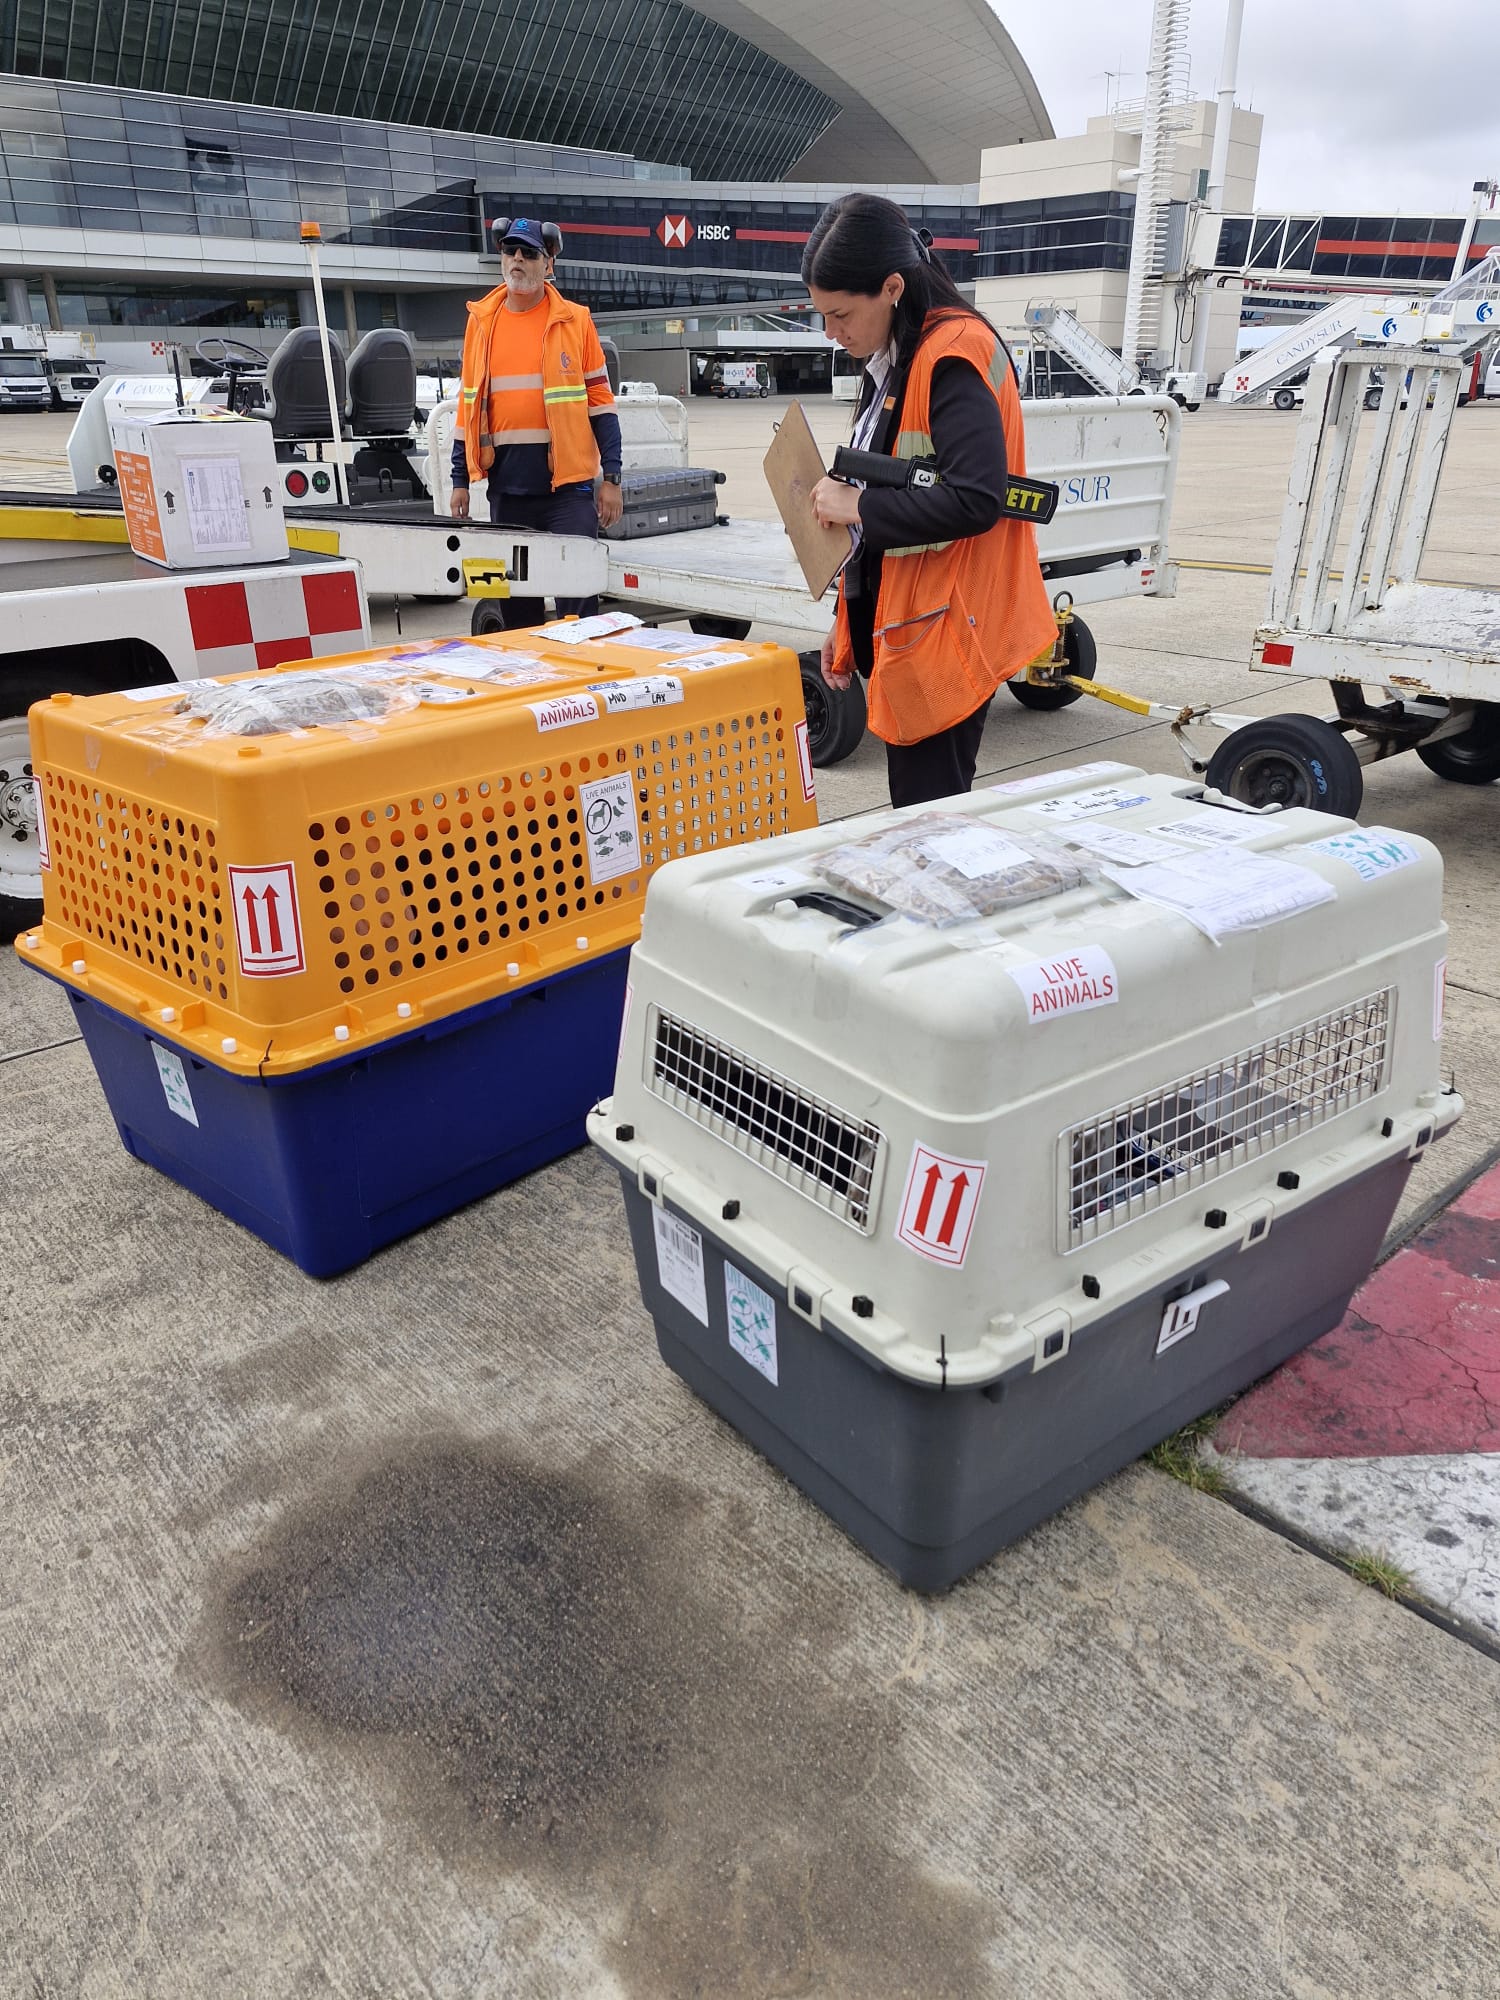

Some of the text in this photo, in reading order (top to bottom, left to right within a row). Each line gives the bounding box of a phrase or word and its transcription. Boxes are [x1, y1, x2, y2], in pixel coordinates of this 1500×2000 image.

[697, 225, 731, 240] HSBC
[919, 472, 931, 483] 3
[1006, 486, 1046, 512] ETT
[546, 696, 577, 709] LIVE
[651, 692, 666, 705] LAX
[540, 701, 596, 727] ANIMALS
[585, 781, 628, 800] LIVE ANIMALS
[1040, 958, 1089, 984] LIVE
[1032, 975, 1114, 1016] ANIMALS
